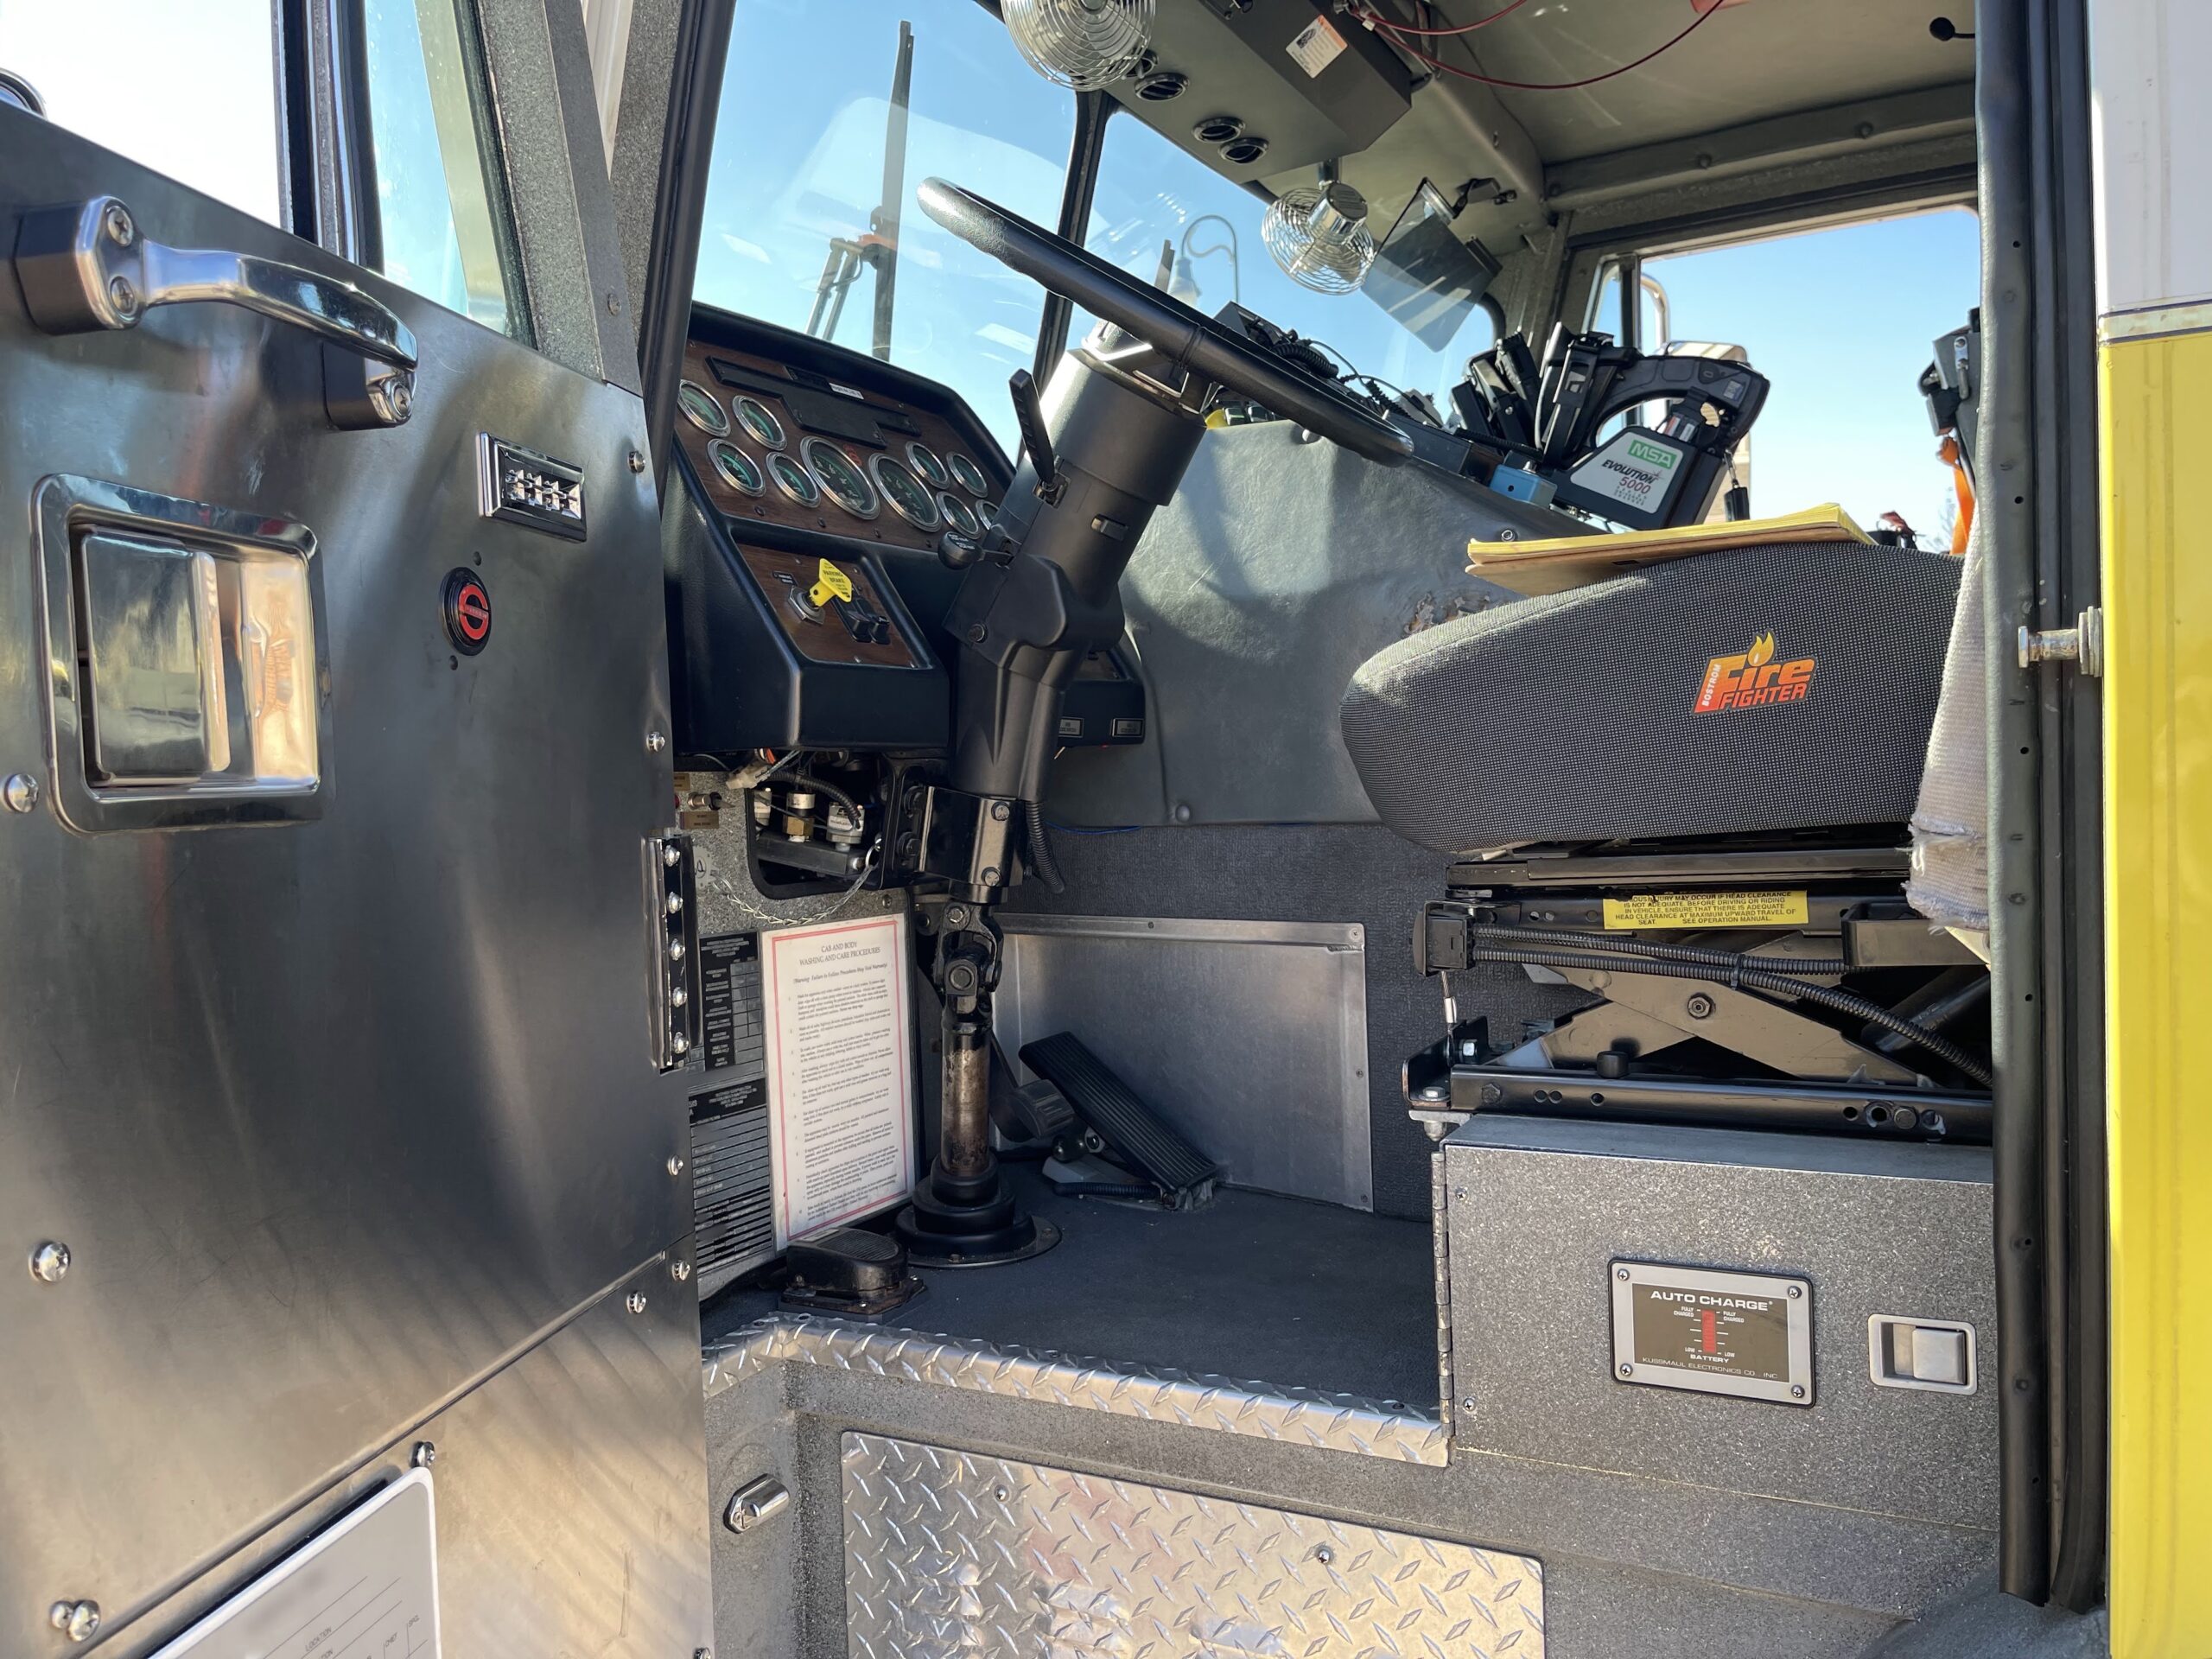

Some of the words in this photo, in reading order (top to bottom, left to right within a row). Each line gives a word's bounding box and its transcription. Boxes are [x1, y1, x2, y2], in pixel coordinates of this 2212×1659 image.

[1631, 442, 1673, 467] MSA
[1602, 460, 1656, 484] EVOLUTION
[1619, 477, 1651, 495] 5000
[1694, 654, 1815, 712] Fire
[1702, 664, 1721, 707] BOSTROM
[1719, 683, 1808, 709] FIGHTER
[799, 956, 823, 965] WASHING
[850, 947, 880, 957] PROCEDURES
[1651, 1291, 1695, 1304] AUTO
[1643, 1357, 1686, 1368] KUSSMAUL
[1688, 1363, 1741, 1374] ELECTRONICS
[1690, 1354, 1729, 1363] BATTERY
